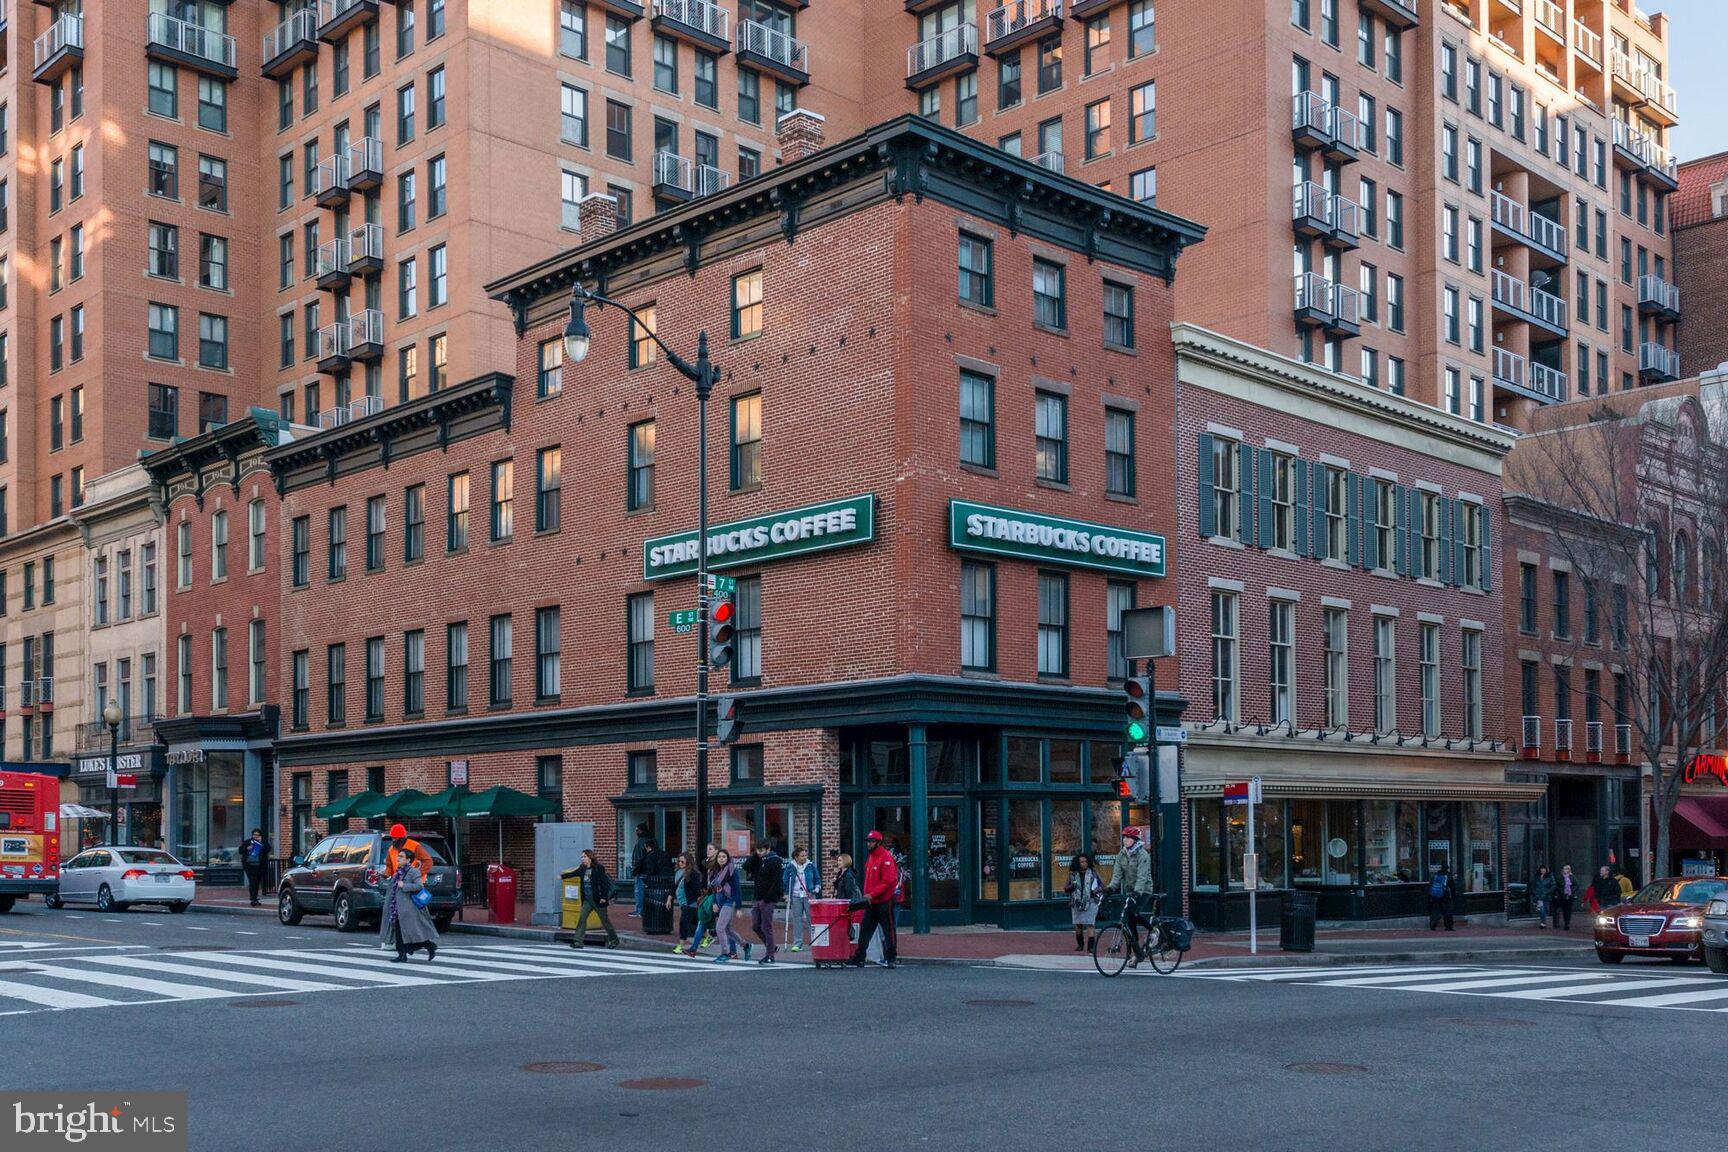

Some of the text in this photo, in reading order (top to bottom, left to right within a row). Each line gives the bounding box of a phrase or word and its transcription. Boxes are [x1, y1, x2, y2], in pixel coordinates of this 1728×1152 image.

[770, 508, 857, 544] COFFEE
[966, 513, 1161, 564] STARBUCKS COFFEE
[719, 578, 725, 589] 7
[714, 589, 728, 598] 400
[676, 613, 682, 624] E
[676, 624, 691, 633] 600
[80, 754, 142, 772] LUKE'S LBSTER
